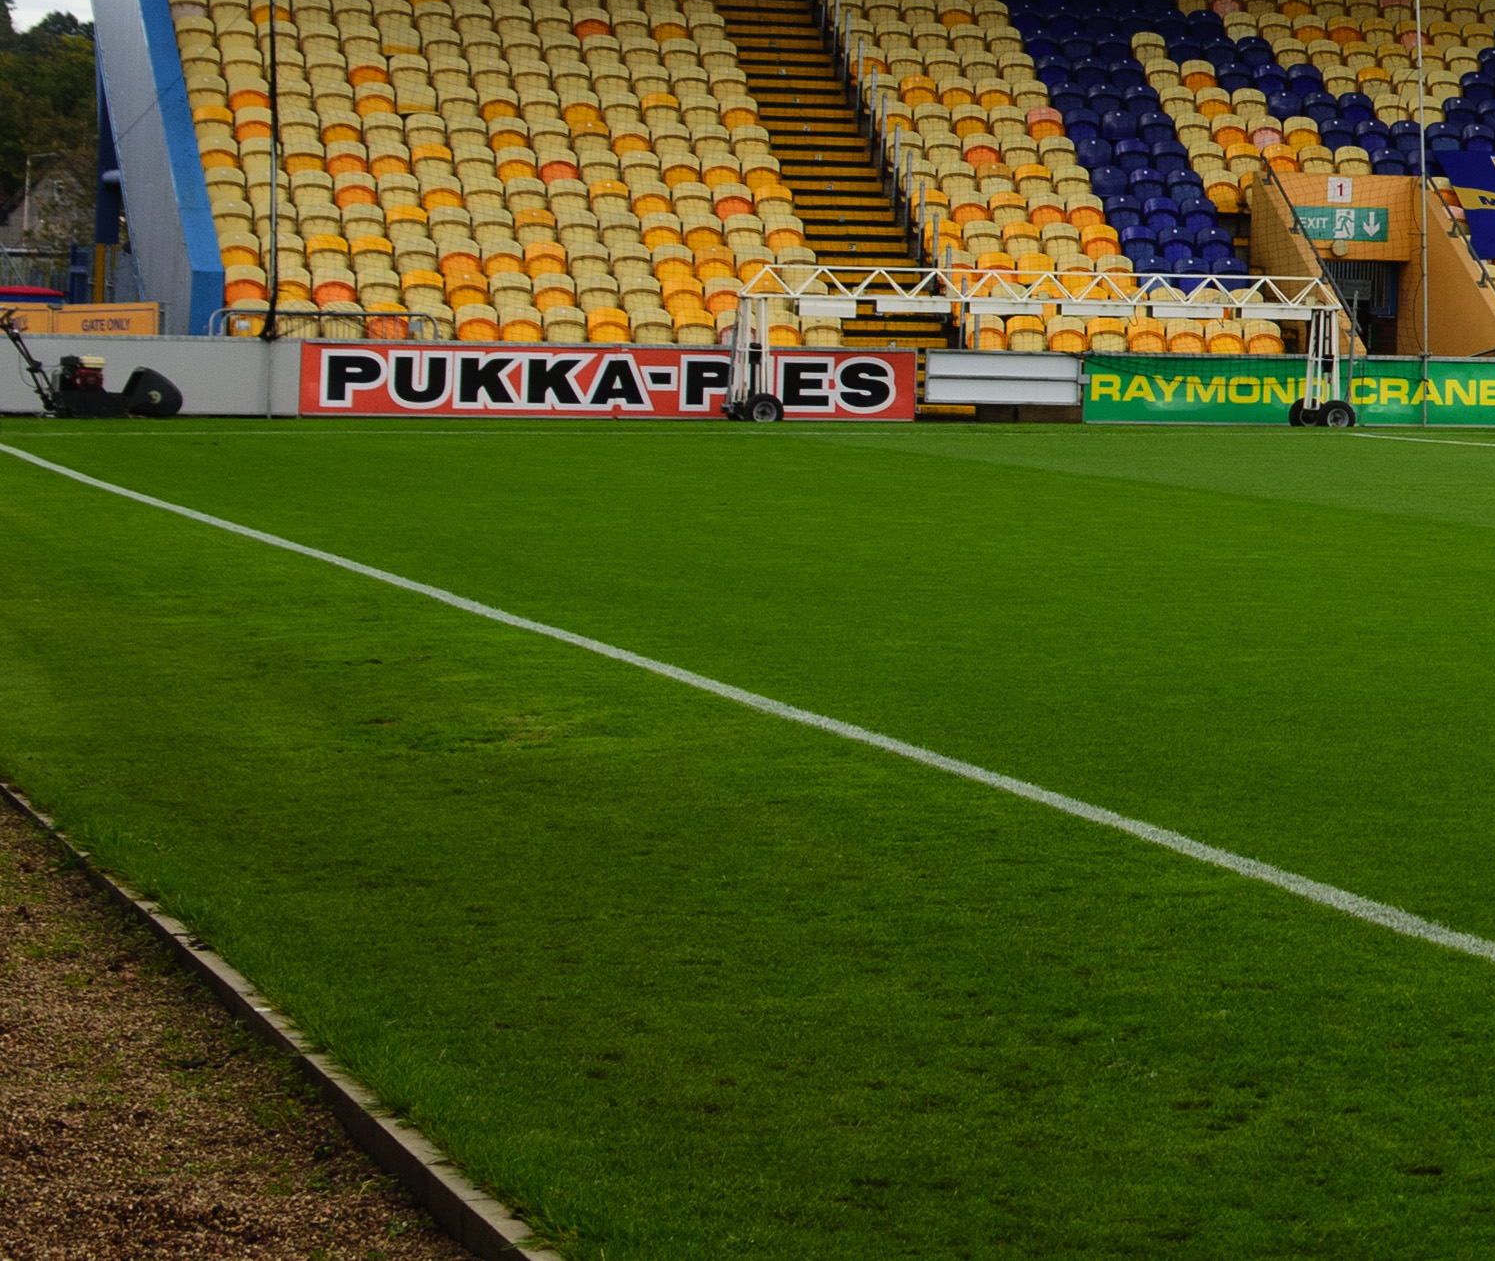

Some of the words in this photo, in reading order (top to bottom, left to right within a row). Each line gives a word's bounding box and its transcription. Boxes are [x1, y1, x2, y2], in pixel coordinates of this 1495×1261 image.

[1336, 183, 1344, 197] 1
[1298, 216, 1329, 229] EXIT
[322, 350, 895, 412] PUKKA-PES
